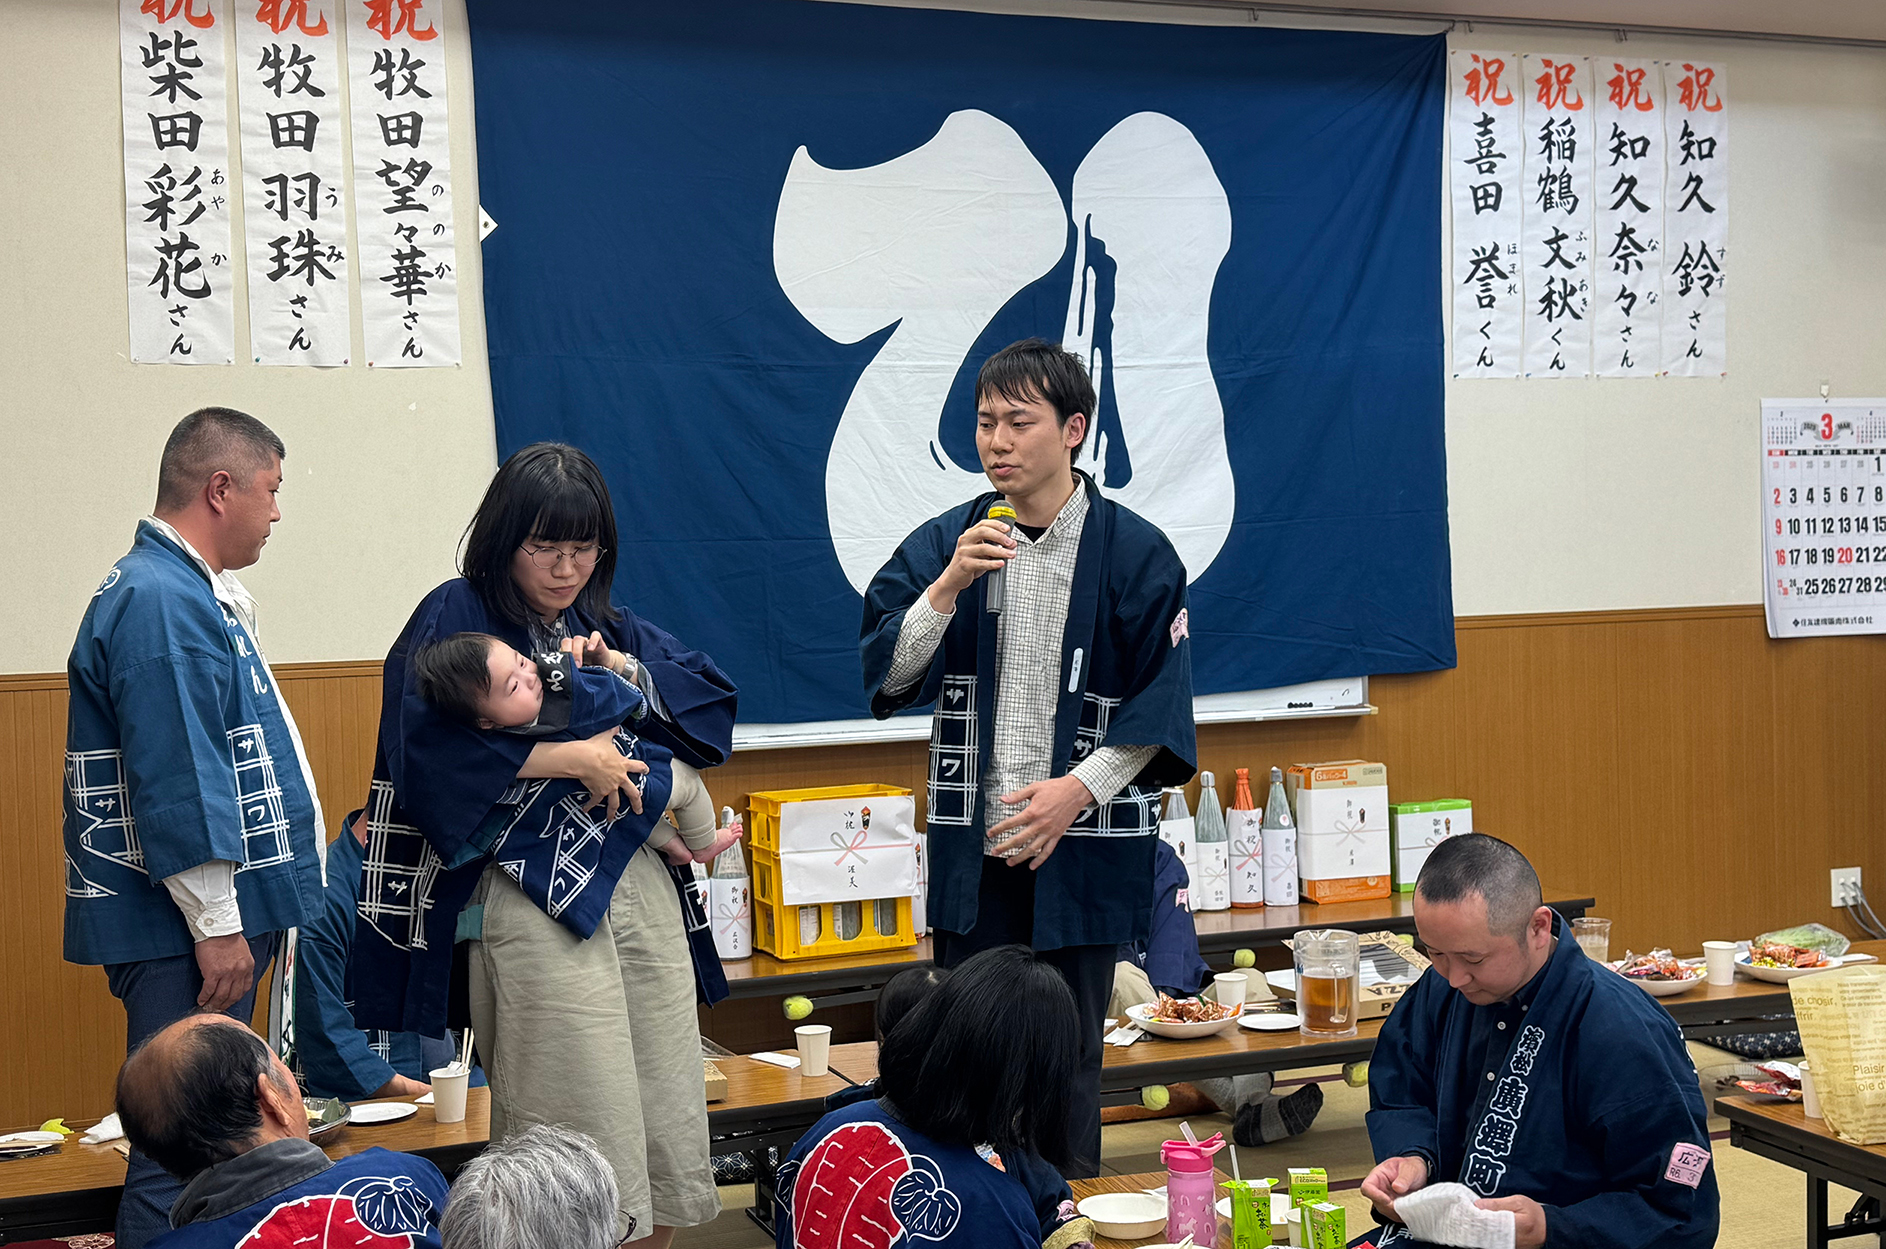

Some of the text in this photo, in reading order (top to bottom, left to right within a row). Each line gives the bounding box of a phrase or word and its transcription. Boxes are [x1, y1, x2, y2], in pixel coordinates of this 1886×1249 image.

[1463, 53, 1514, 107] 祝
[1535, 58, 1584, 111] 祝
[1606, 63, 1654, 112] 祝
[1676, 63, 1723, 112] 祝
[139, 30, 212, 356] 柴田彩花さん
[256, 43, 336, 352] 牧田羽珠さん
[369, 47, 435, 359] 牧田望々華さん
[1535, 116, 1583, 371] 稲鶴文秋くん
[1608, 121, 1651, 368] 知久奈々さん
[1507, 243, 1519, 295] ほまれ
[1715, 246, 1726, 289] すず
[1821, 413, 1833, 440] 3
[1875, 456, 1881, 472] 1
[1774, 486, 1883, 505] 2 3 4 5 6 7 8
[1775, 516, 1886, 535] 9 10 11 12 13 14 15
[1776, 548, 1786, 566] 16
[1788, 549, 1800, 565] 17
[1805, 548, 1817, 565] 18
[1822, 547, 1835, 564] 19
[1838, 547, 1853, 564] 20
[1856, 546, 1870, 563] 21
[1789, 579, 1797, 587] 24
[1805, 578, 1819, 595] 25
[1821, 578, 1836, 594] 26
[1838, 578, 1853, 594] 27
[1856, 577, 1871, 593] 28
[1796, 587, 1803, 596] 31
[1246, 818, 1257, 845] 御祝
[1853, 1063, 1885, 1075] Plaisir
[1855, 1080, 1876, 1094] joie
